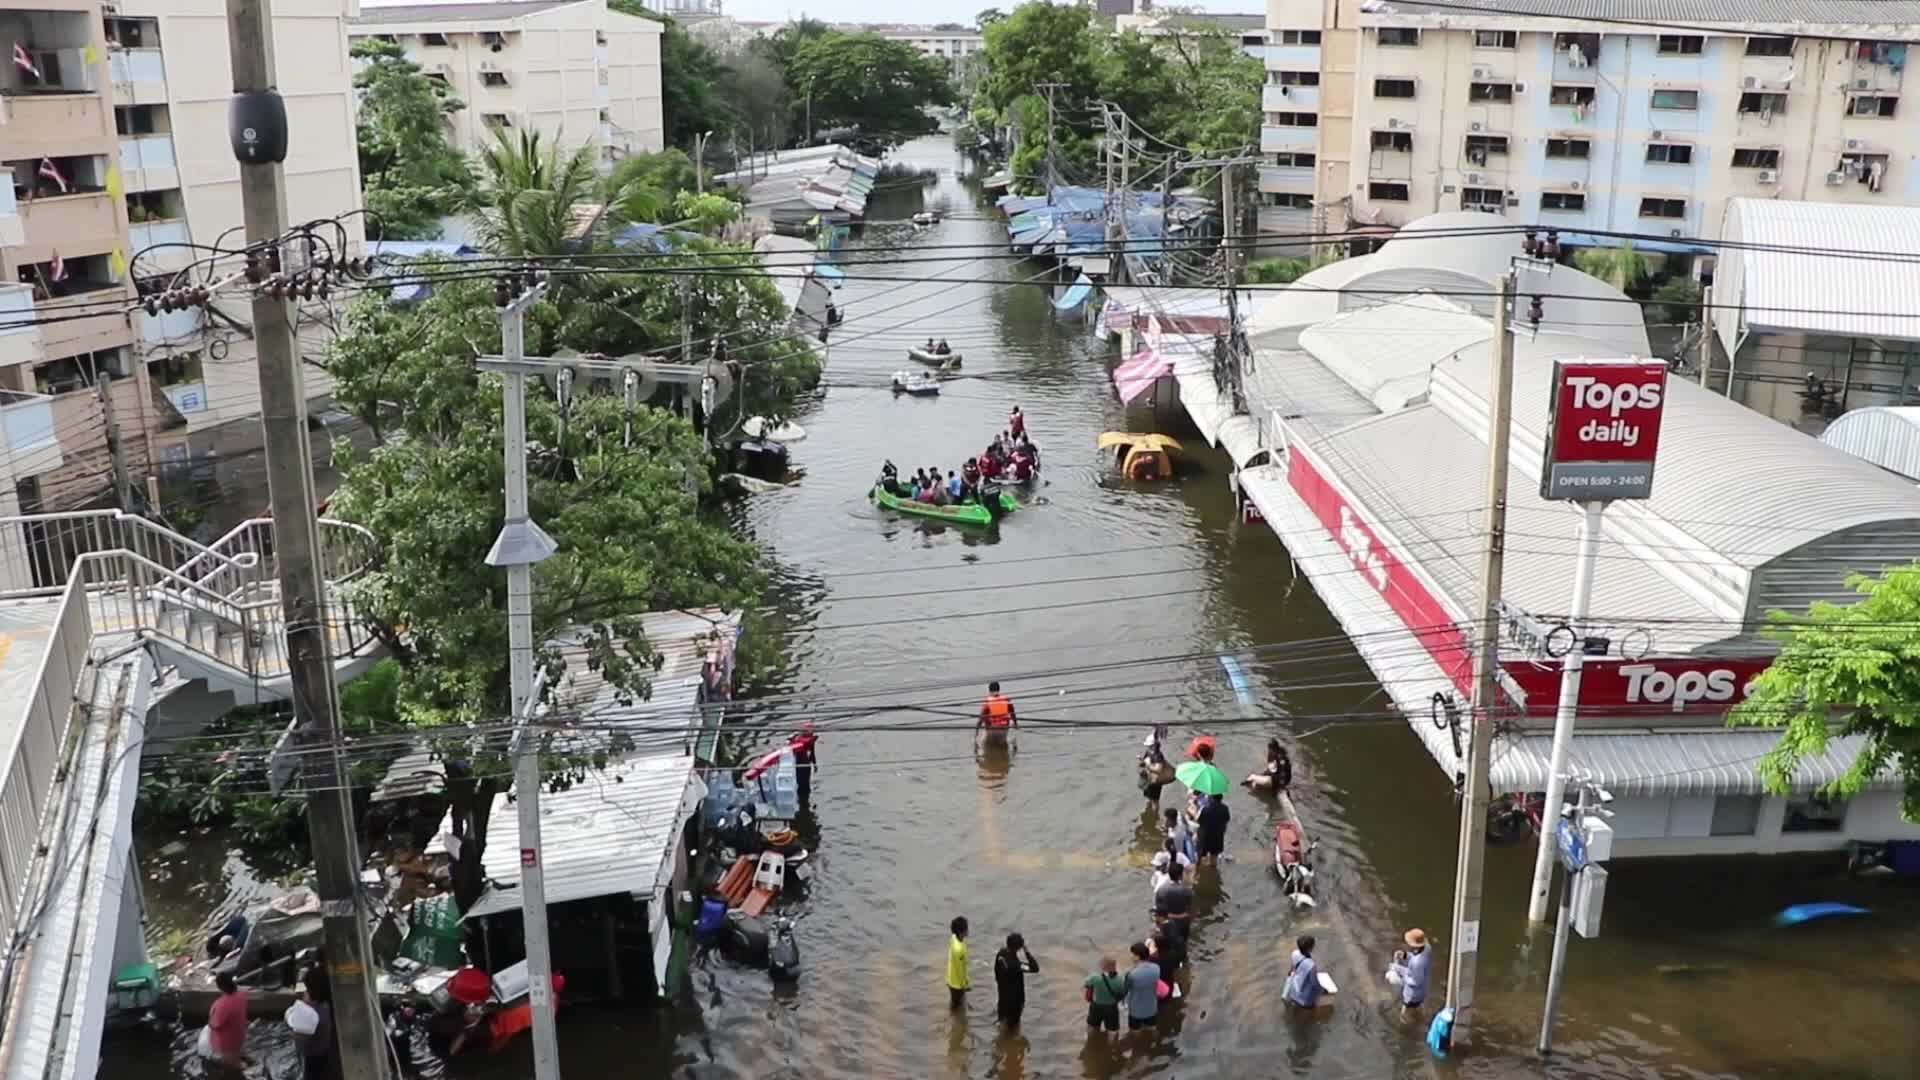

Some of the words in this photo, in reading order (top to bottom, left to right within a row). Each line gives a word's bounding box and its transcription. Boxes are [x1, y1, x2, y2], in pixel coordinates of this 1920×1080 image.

[1566, 376, 1661, 417] Tops
[1579, 419, 1639, 447] daily
[1559, 476, 1588, 486] OPEN
[1619, 664, 1736, 712] Tops
